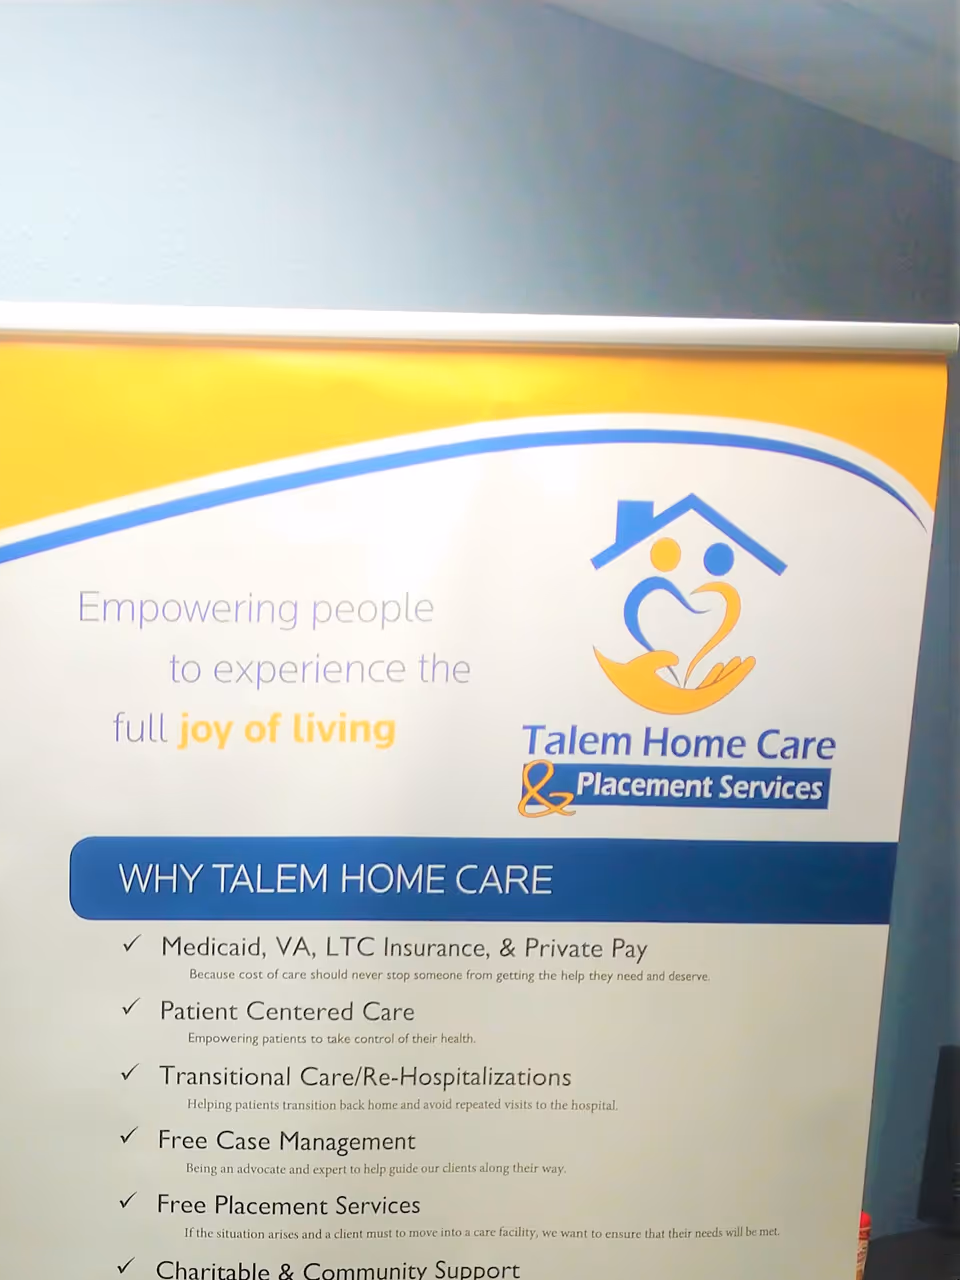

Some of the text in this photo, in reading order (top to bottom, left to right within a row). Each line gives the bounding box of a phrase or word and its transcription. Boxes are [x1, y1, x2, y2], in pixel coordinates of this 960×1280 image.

[80, 590, 434, 631] Empowering people
[169, 653, 470, 689] to experience the
[113, 711, 396, 750] full joy of living
[522, 725, 836, 760] Talem Home Care
[576, 771, 714, 798] Placement
[718, 775, 823, 800] Services
[119, 863, 553, 895] WHY TALEM HOME CARE
[162, 936, 648, 964] Medicaid, VA, LTC Insurance, & Private Pay
[190, 968, 710, 984] Because cost of care should never stop someone from getting the help they need and deserve.
[161, 1000, 414, 1021] Patient Centered Care
[188, 1032, 476, 1047] Empowering patients to take control of their health.
[159, 1065, 571, 1091] Transitional Care/Re-Hospitalizations
[187, 1098, 618, 1114] Helping patients transition back home and avoid repeated visits to the hospital.
[159, 1129, 416, 1156] Free Case Management
[158, 1193, 420, 1216] Free Placement Services
